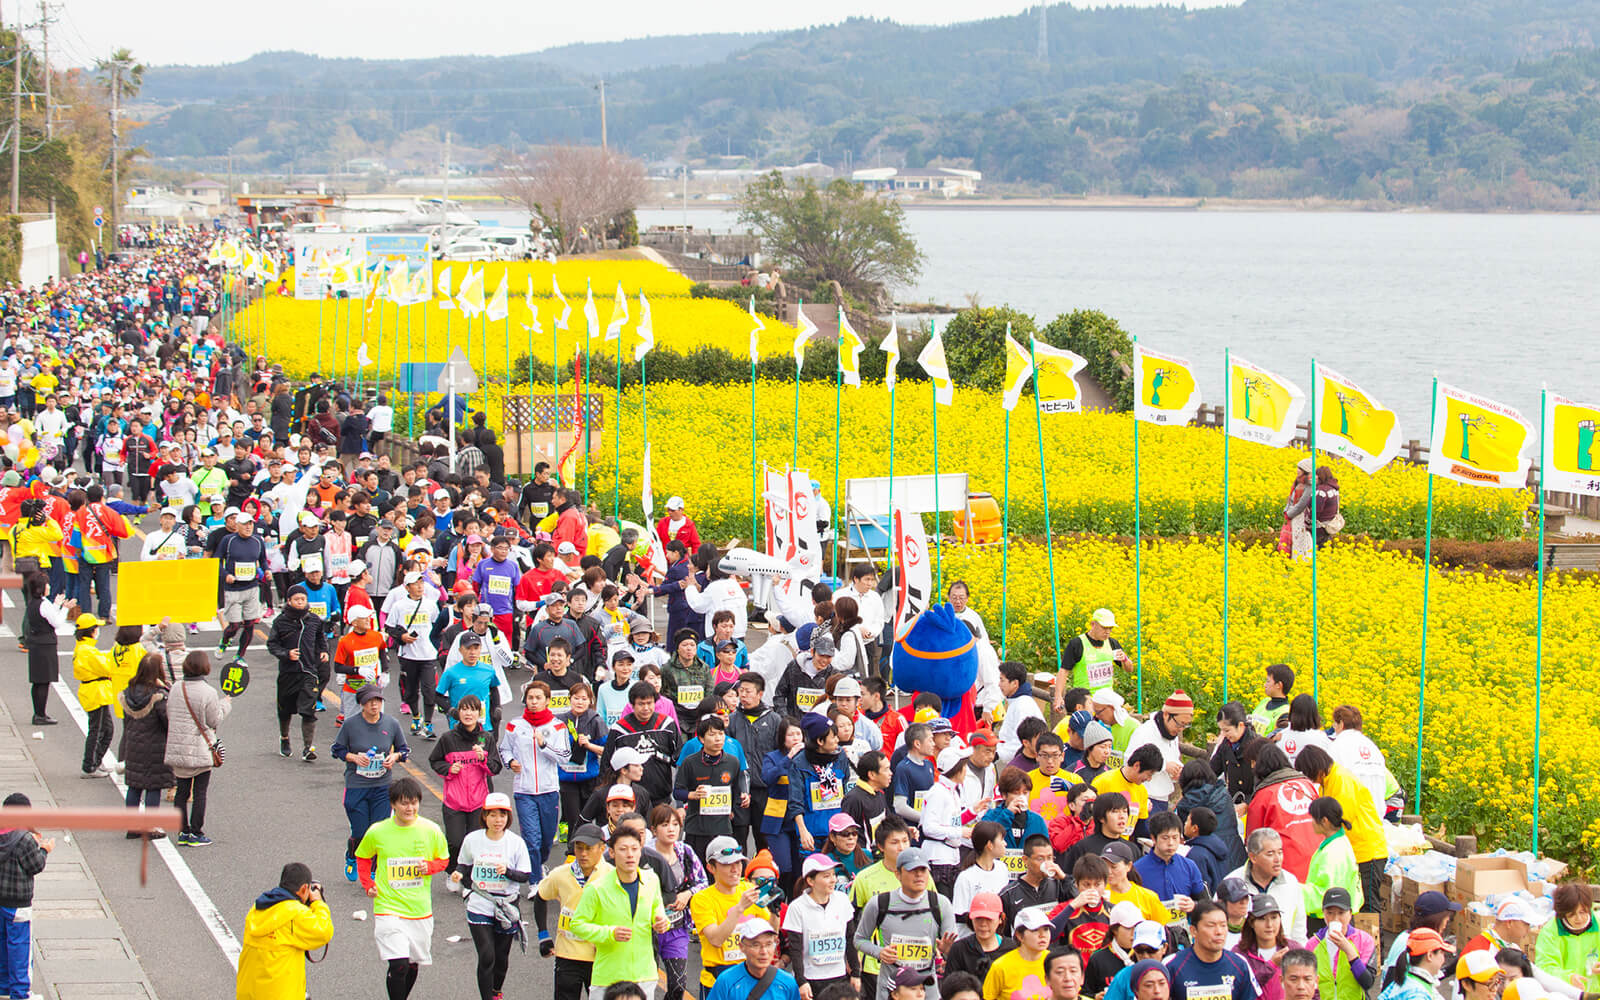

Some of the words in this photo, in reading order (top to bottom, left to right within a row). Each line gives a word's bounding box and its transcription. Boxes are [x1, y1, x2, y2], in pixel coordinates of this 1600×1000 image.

[1090, 667, 1112, 680] 16164
[551, 697, 568, 706] 562
[679, 692, 702, 700] 11724
[812, 938, 843, 952] 19532
[901, 945, 929, 958] 1575
